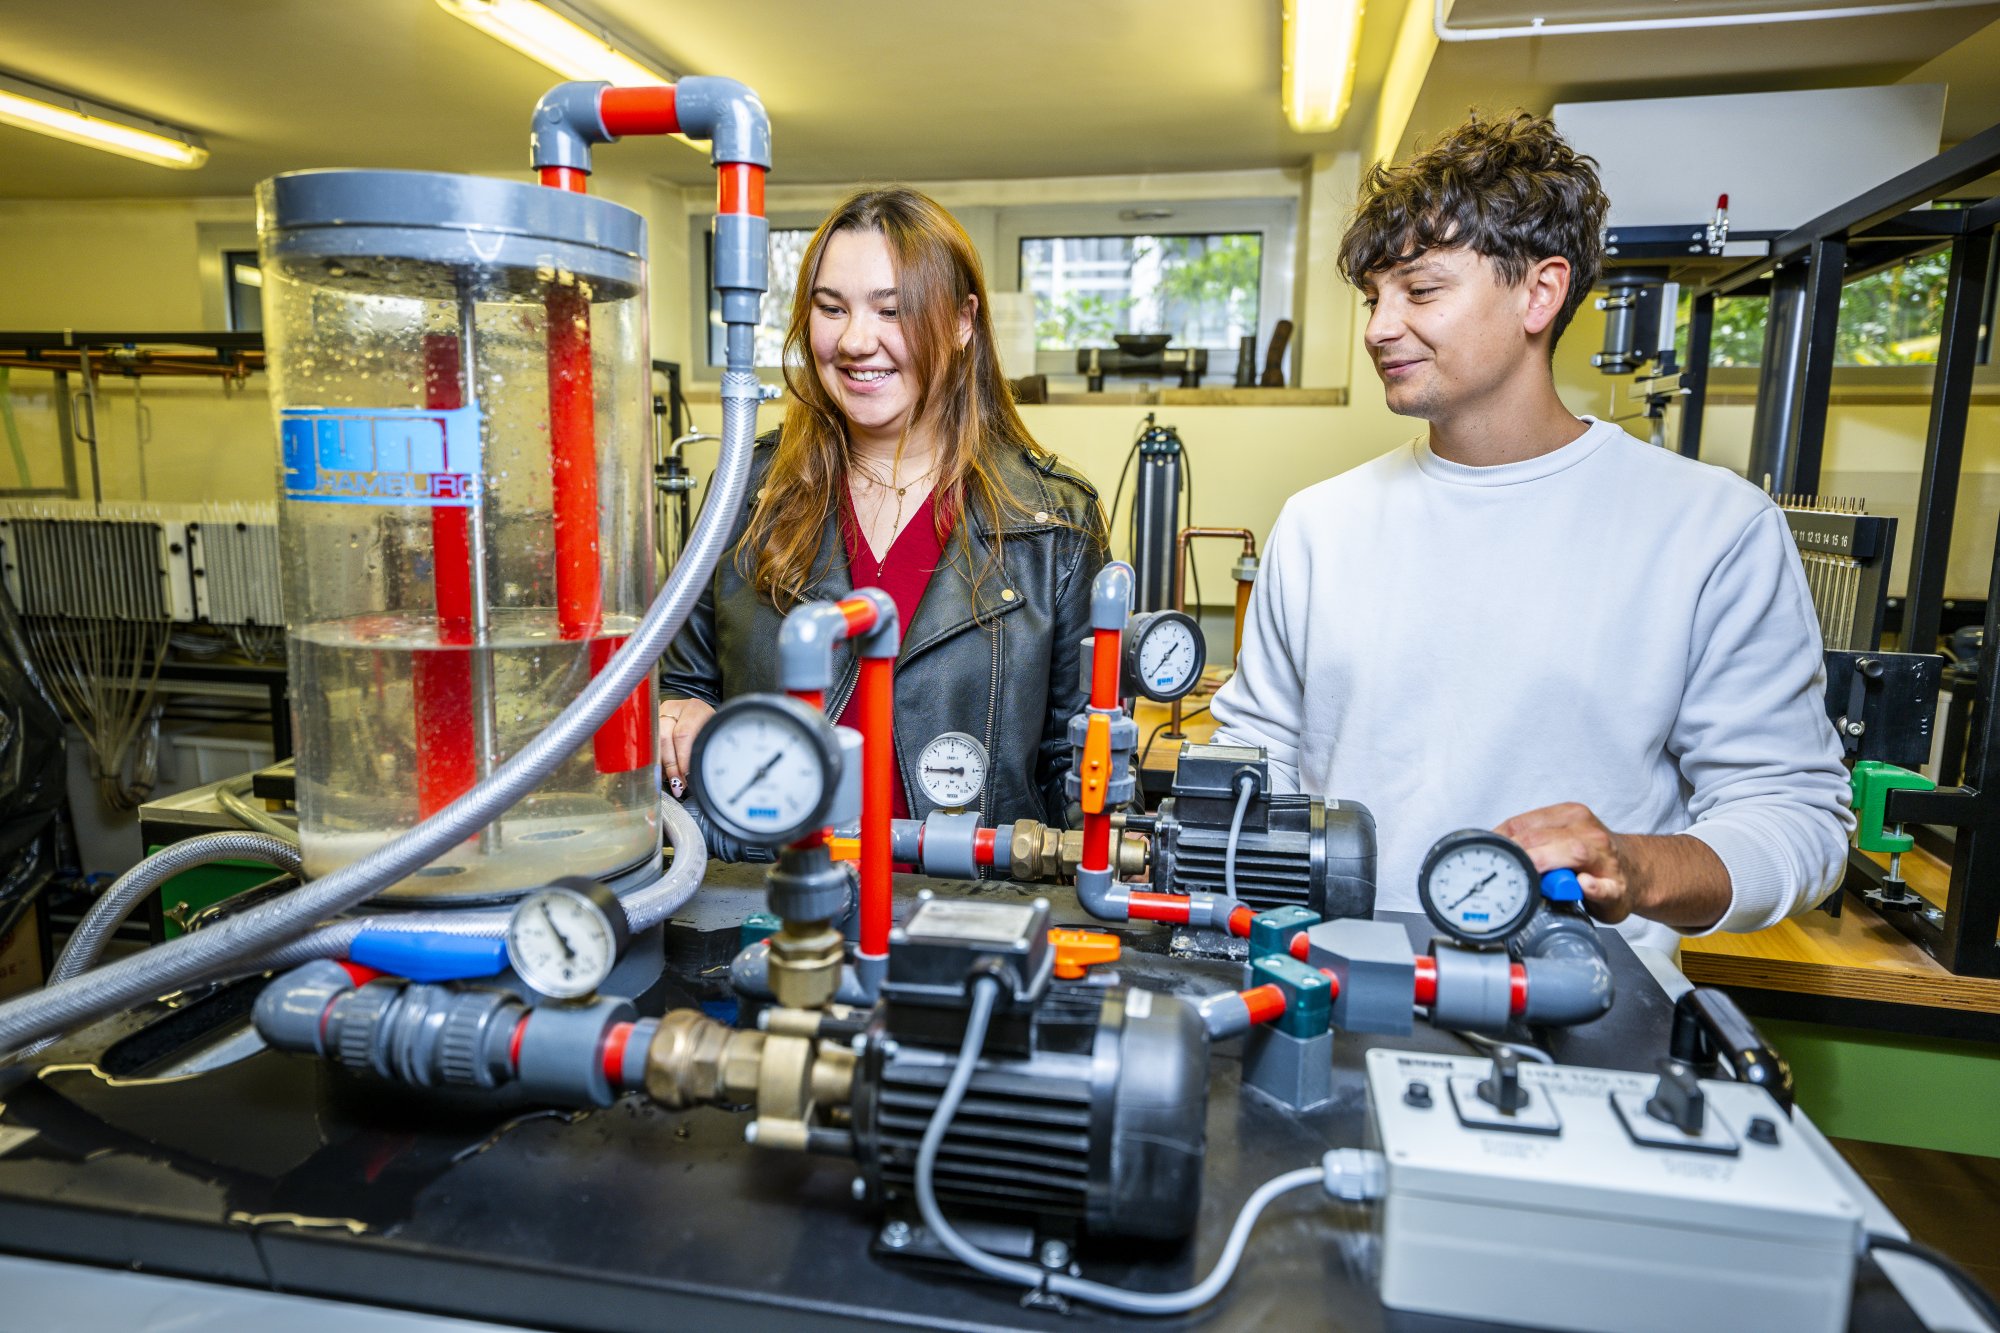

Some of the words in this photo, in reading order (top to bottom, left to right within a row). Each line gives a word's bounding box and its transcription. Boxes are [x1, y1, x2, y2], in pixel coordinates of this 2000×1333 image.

[317, 473, 483, 497] HAMBURG
[1799, 530, 1806, 541] 11
[1807, 531, 1814, 543] 12
[1814, 532, 1821, 544] 13
[1823, 533, 1830, 545] 14
[1832, 534, 1839, 546] 15
[1841, 535, 1848, 548] 16
